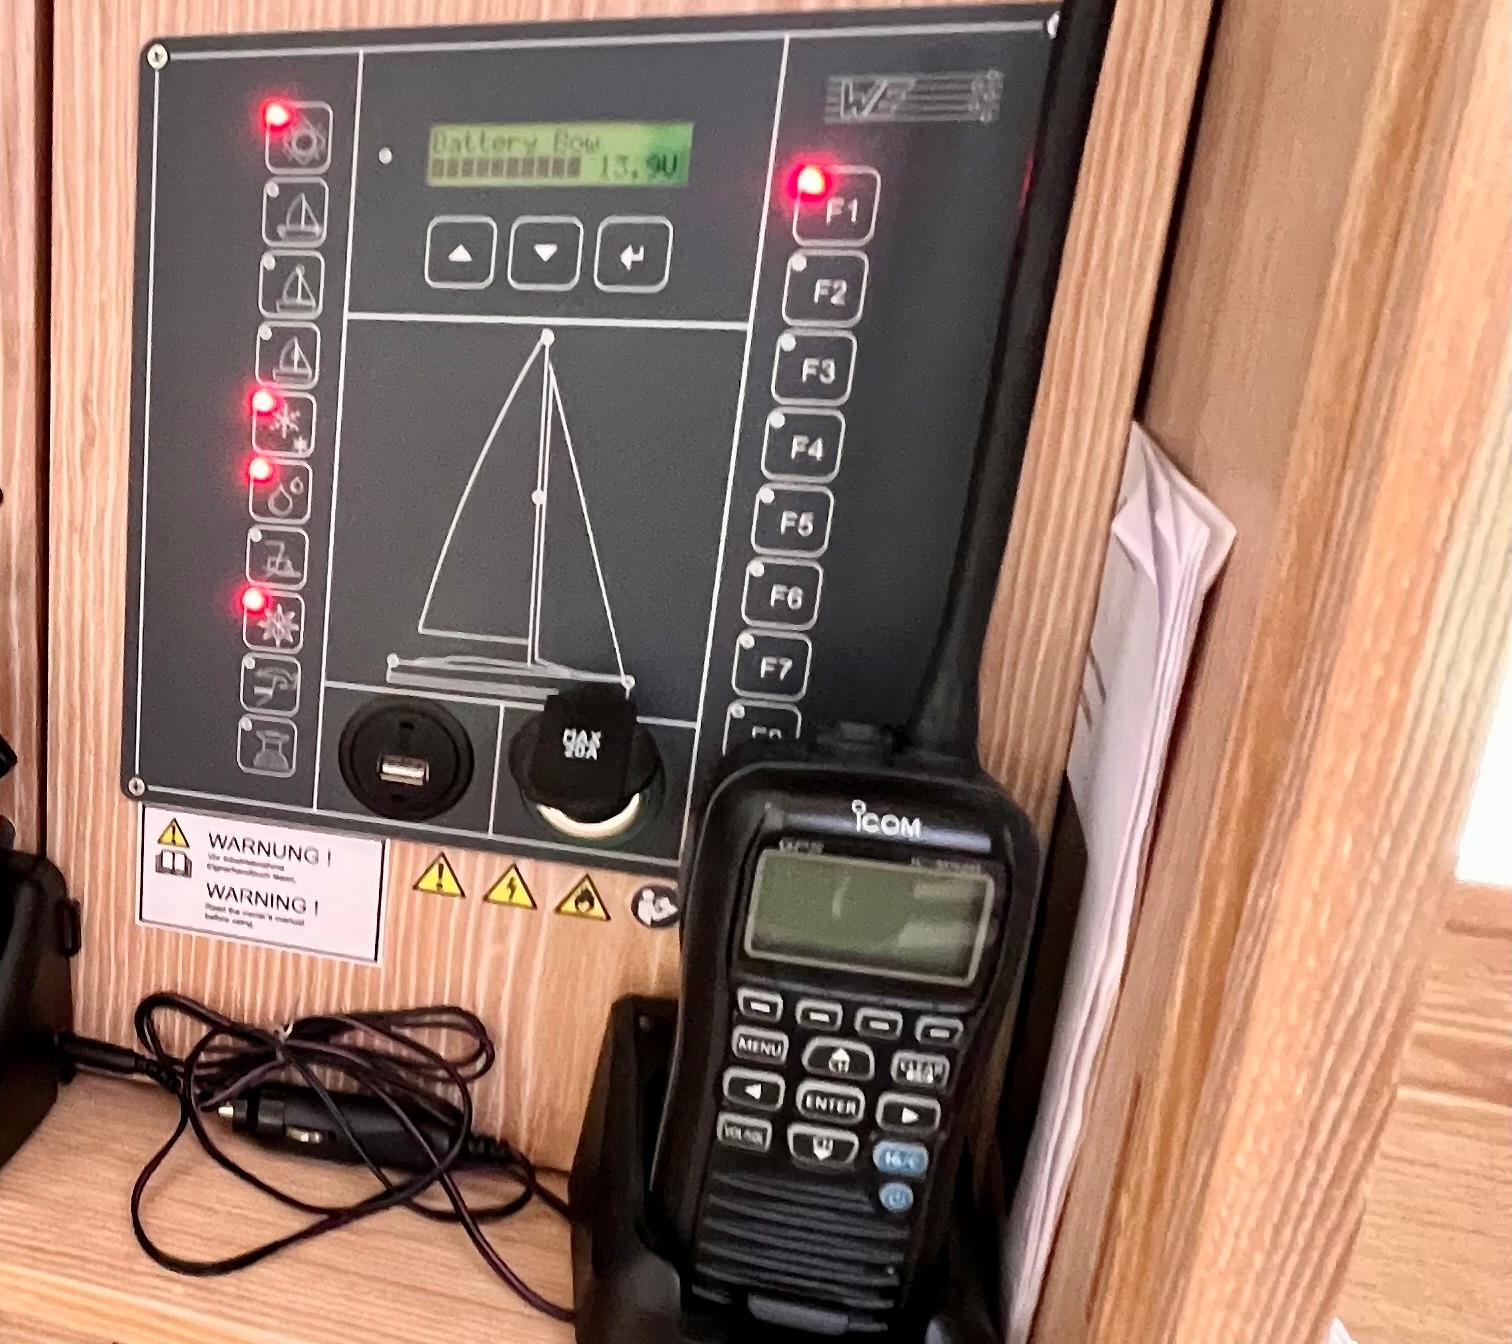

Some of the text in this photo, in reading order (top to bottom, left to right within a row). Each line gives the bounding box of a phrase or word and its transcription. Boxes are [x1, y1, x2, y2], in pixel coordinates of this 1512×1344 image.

[432, 129, 539, 154] Battery
[825, 196, 859, 224] F1
[813, 278, 848, 306] F2
[801, 357, 836, 384] F3
[790, 435, 824, 462] F4
[779, 510, 814, 537] F5
[769, 584, 804, 610] F6
[759, 656, 794, 681] F7
[208, 831, 321, 866] WARNUNG
[205, 881, 308, 916] WARNING
[737, 1035, 783, 1057] MENU
[804, 1093, 857, 1115] ENTER
